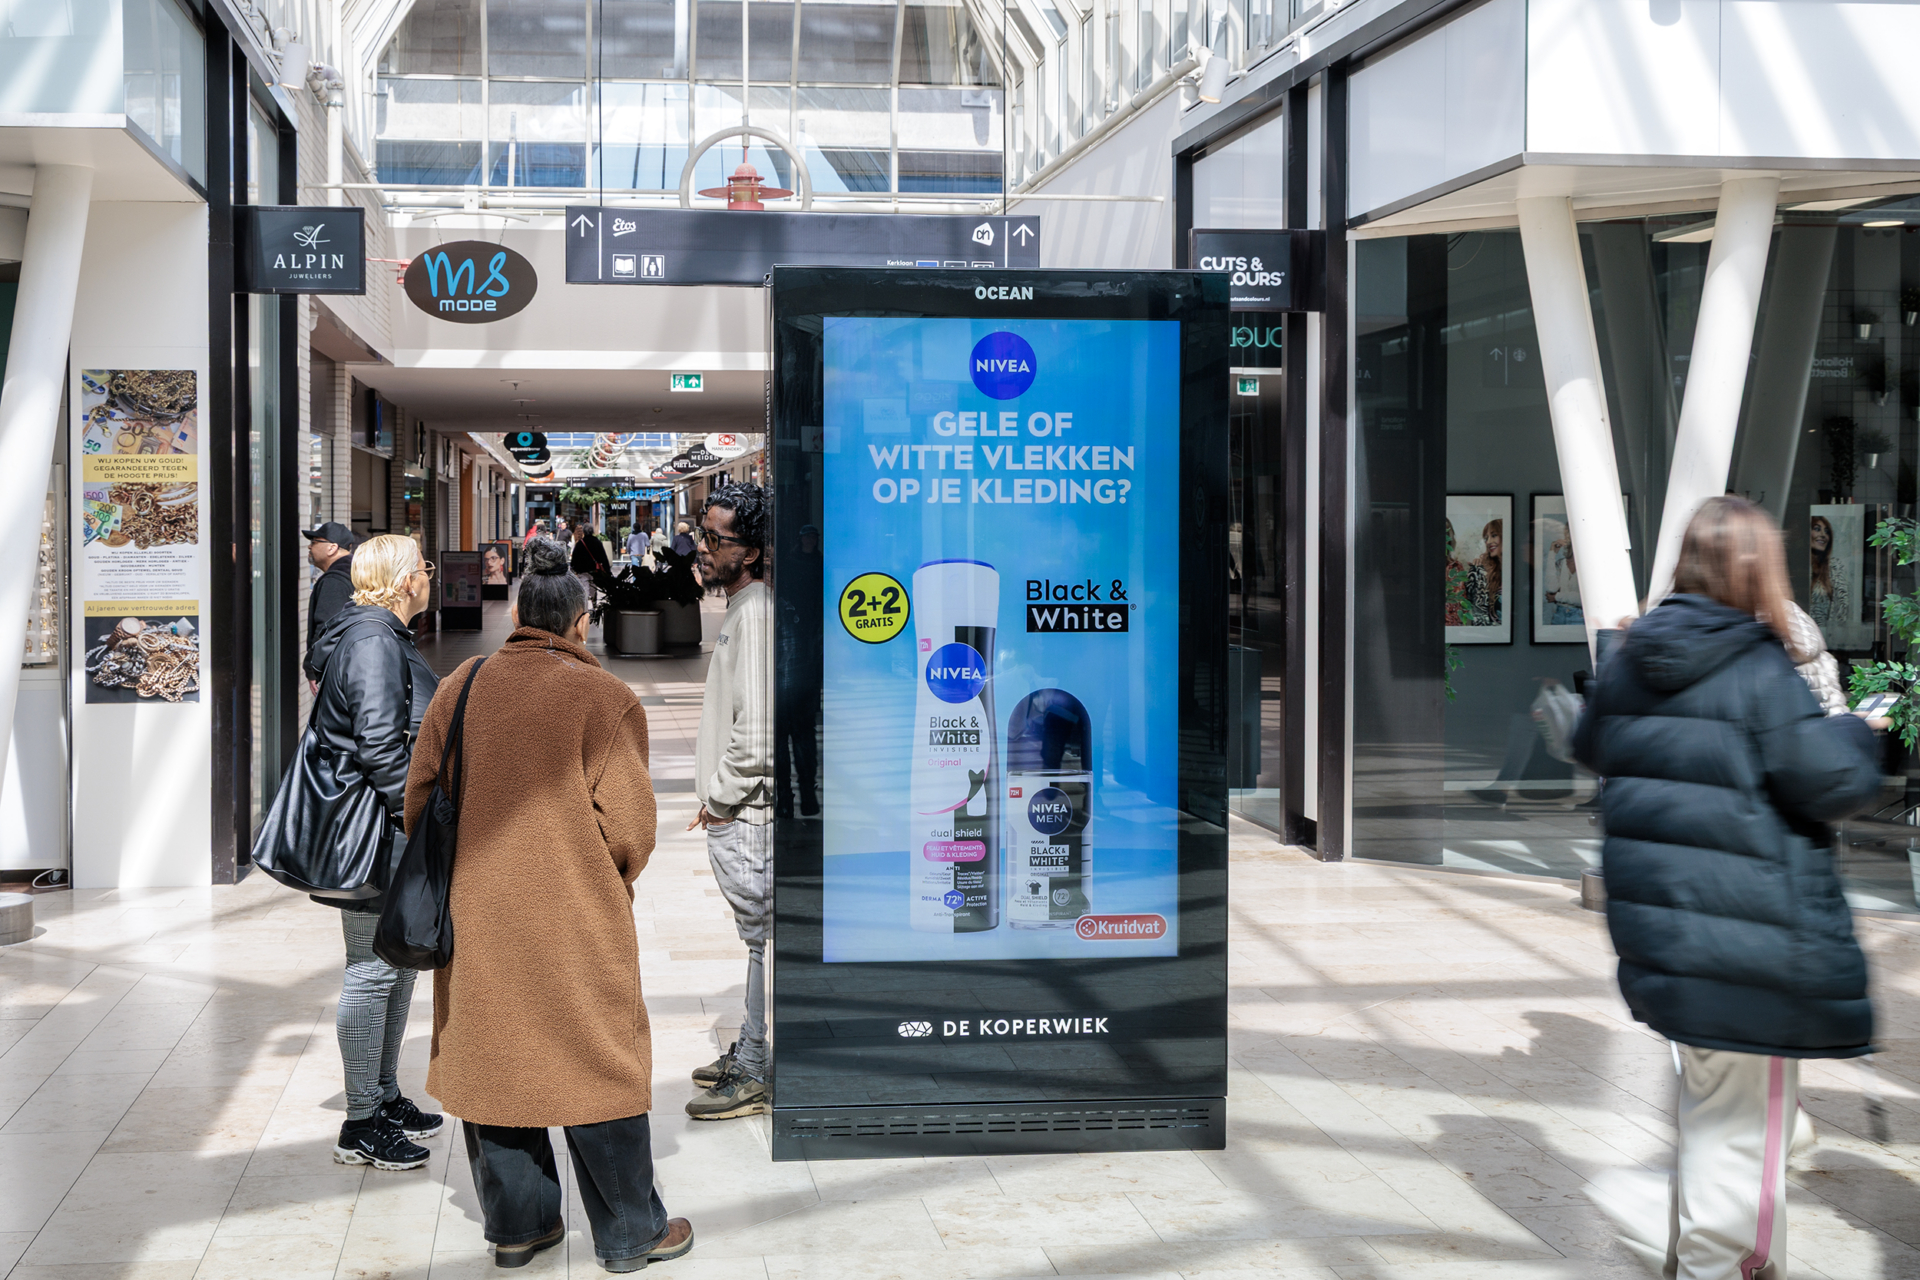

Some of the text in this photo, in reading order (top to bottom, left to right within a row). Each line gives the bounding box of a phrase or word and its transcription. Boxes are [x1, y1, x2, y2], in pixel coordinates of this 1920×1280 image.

[613, 218, 636, 234] Etos
[273, 253, 344, 269] ALPIN
[1200, 256, 1263, 271] CUTS &
[975, 286, 1034, 300] OCEAN
[975, 359, 1031, 373] NIVEA
[933, 411, 1073, 437] GELE OF
[83, 438, 101, 452] 50
[868, 444, 1134, 471] WITTE VLEKKEN
[872, 478, 1131, 505] OP JE KLEDING?
[99, 502, 117, 514] 200
[1026, 579, 1128, 601] Black &
[847, 586, 901, 618] 2+2
[855, 616, 894, 629] GRATIS
[930, 667, 982, 680] NIVEA
[930, 716, 980, 728] Black &
[928, 758, 962, 768] Original
[1032, 803, 1068, 814] NIVEA
[1036, 814, 1063, 823] MEN
[930, 828, 982, 838] dual shield
[1030, 846, 1061, 855] BLACK
[946, 895, 962, 905] 72h
[1098, 919, 1160, 934] Kruidvat
[943, 1017, 1109, 1037] DE KOPERWIEK
